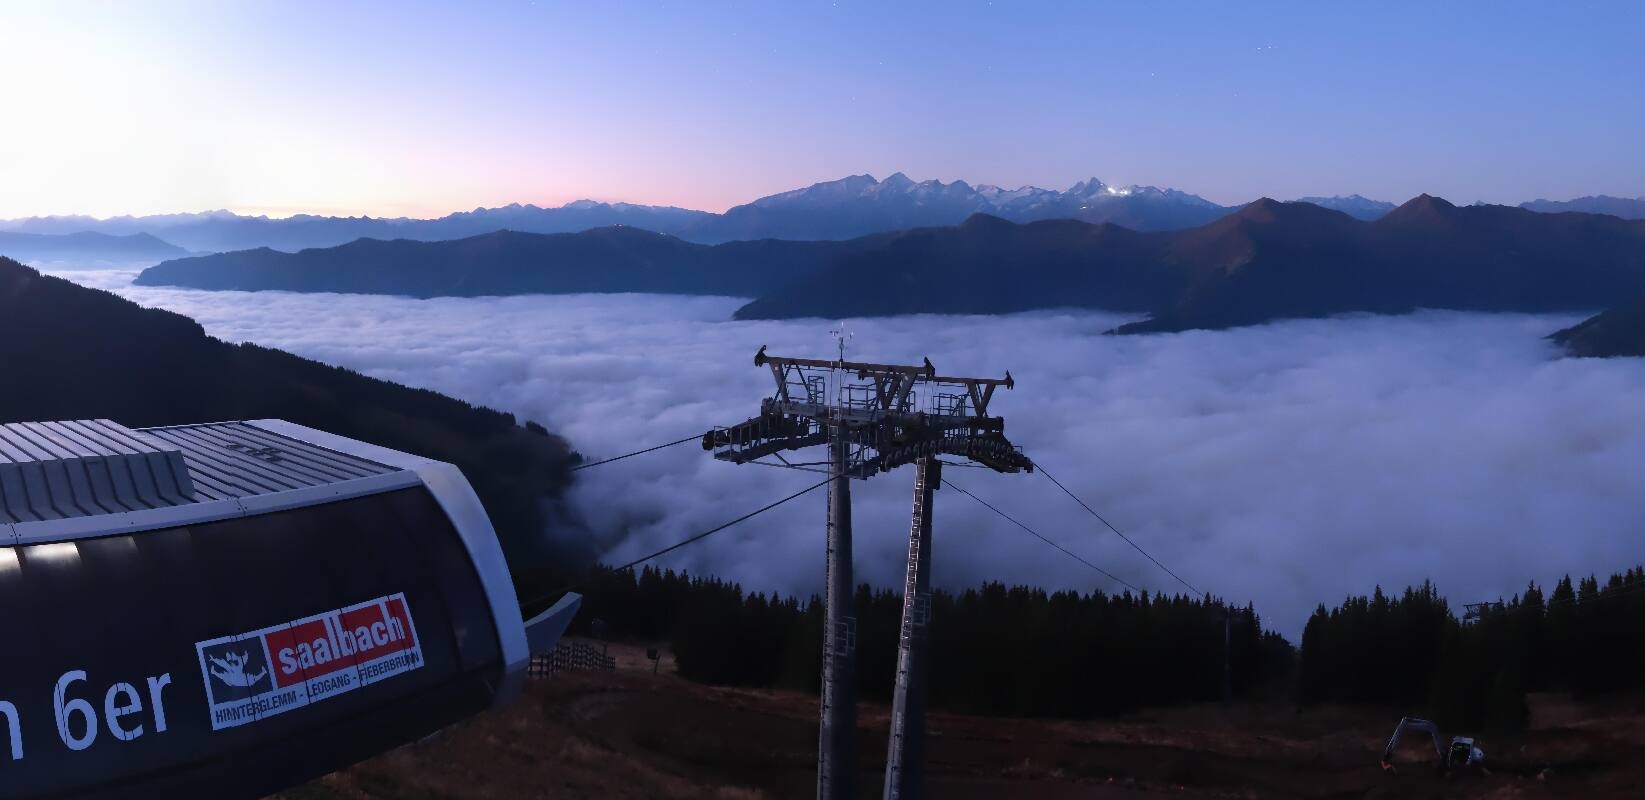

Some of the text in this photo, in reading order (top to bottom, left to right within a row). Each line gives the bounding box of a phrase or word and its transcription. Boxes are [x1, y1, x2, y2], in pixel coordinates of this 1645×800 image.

[278, 601, 406, 675] saalbach
[53, 669, 172, 751] 6er
[306, 673, 352, 698] LEOGANG
